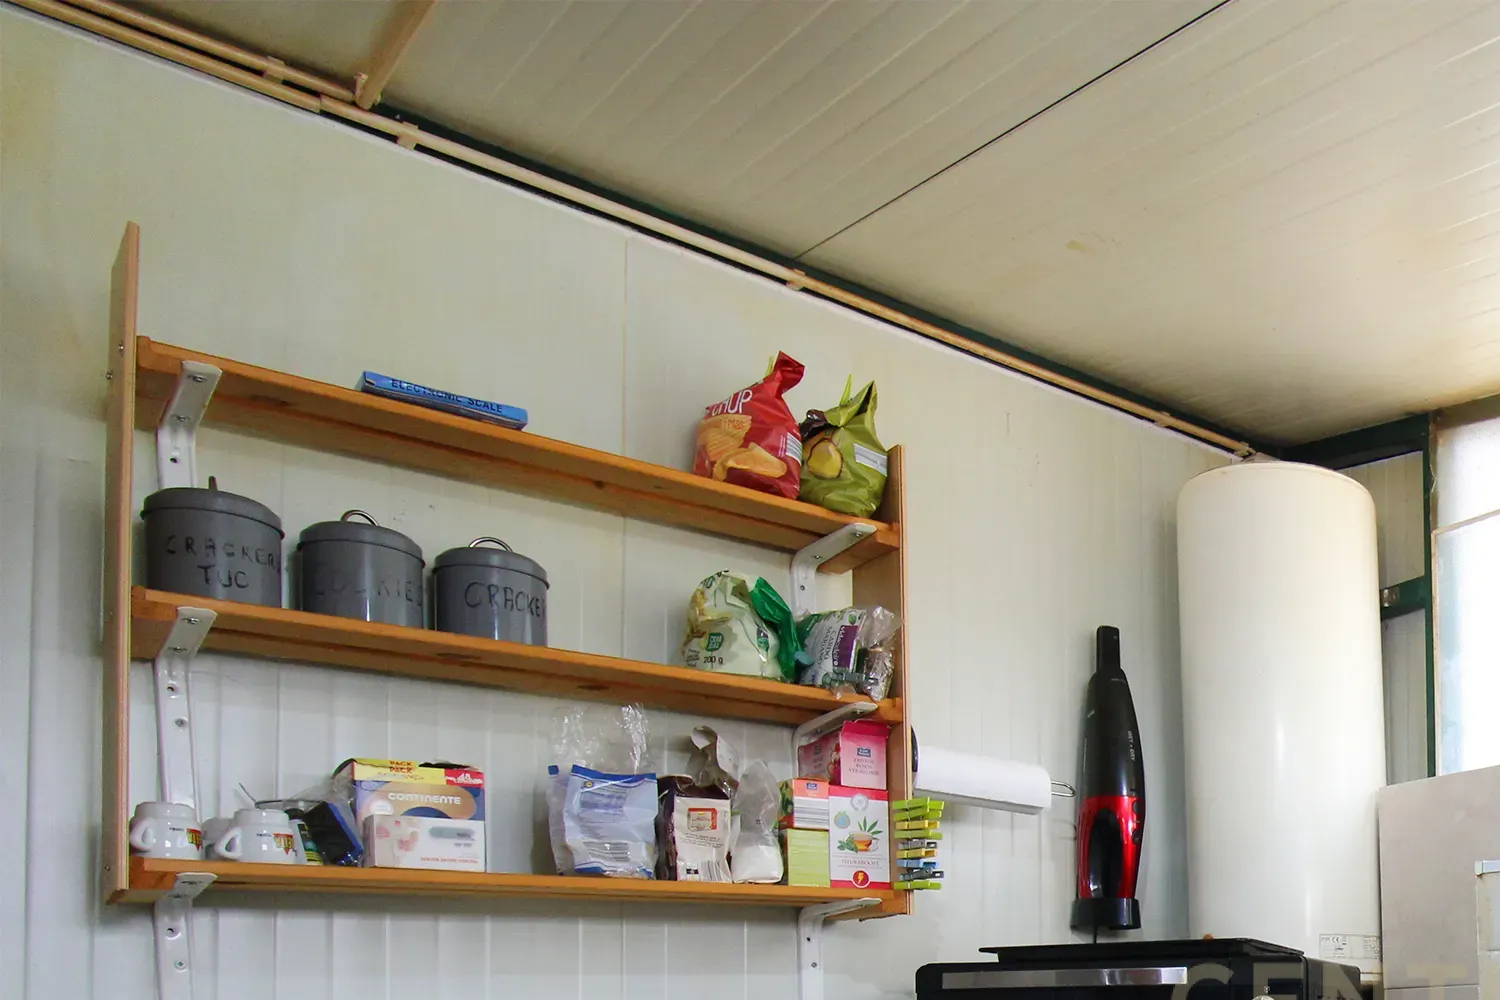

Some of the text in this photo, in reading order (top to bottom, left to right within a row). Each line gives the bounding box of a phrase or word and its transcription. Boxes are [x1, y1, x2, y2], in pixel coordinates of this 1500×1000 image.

[391, 378, 503, 414] ELECTRONIC SCALE
[197, 564, 249, 589] TUC
[703, 656, 717, 664] 200
[387, 792, 462, 805] CONTINENTE
